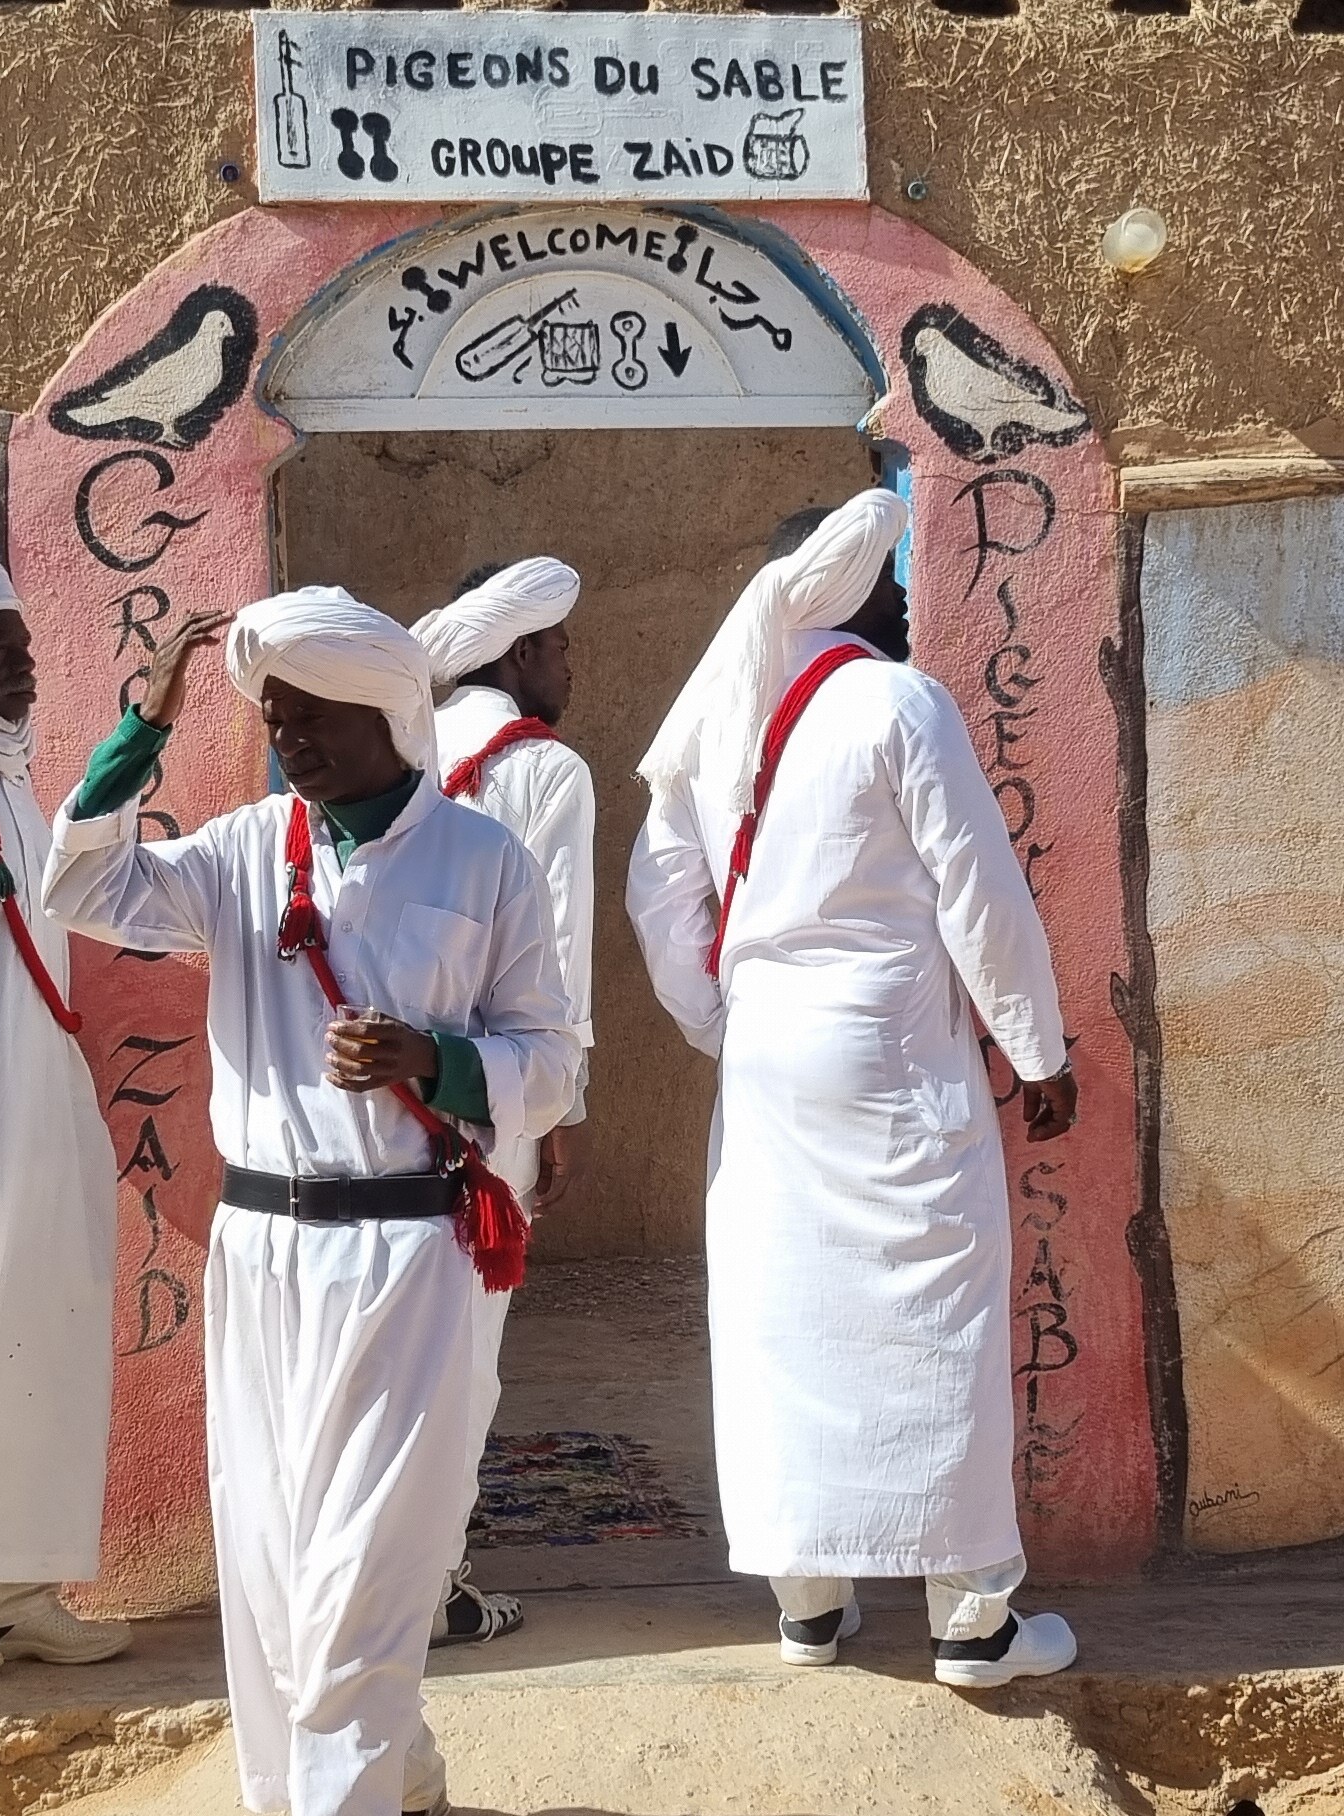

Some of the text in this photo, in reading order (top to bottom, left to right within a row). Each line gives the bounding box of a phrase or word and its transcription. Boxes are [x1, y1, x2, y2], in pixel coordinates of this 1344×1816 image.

[345, 45, 570, 92] PIGEONS
[690, 56, 848, 103] SABLE
[437, 223, 667, 290] WELCOME
[950, 468, 1056, 901] PIGEO
[108, 1034, 197, 1358] ZAID
